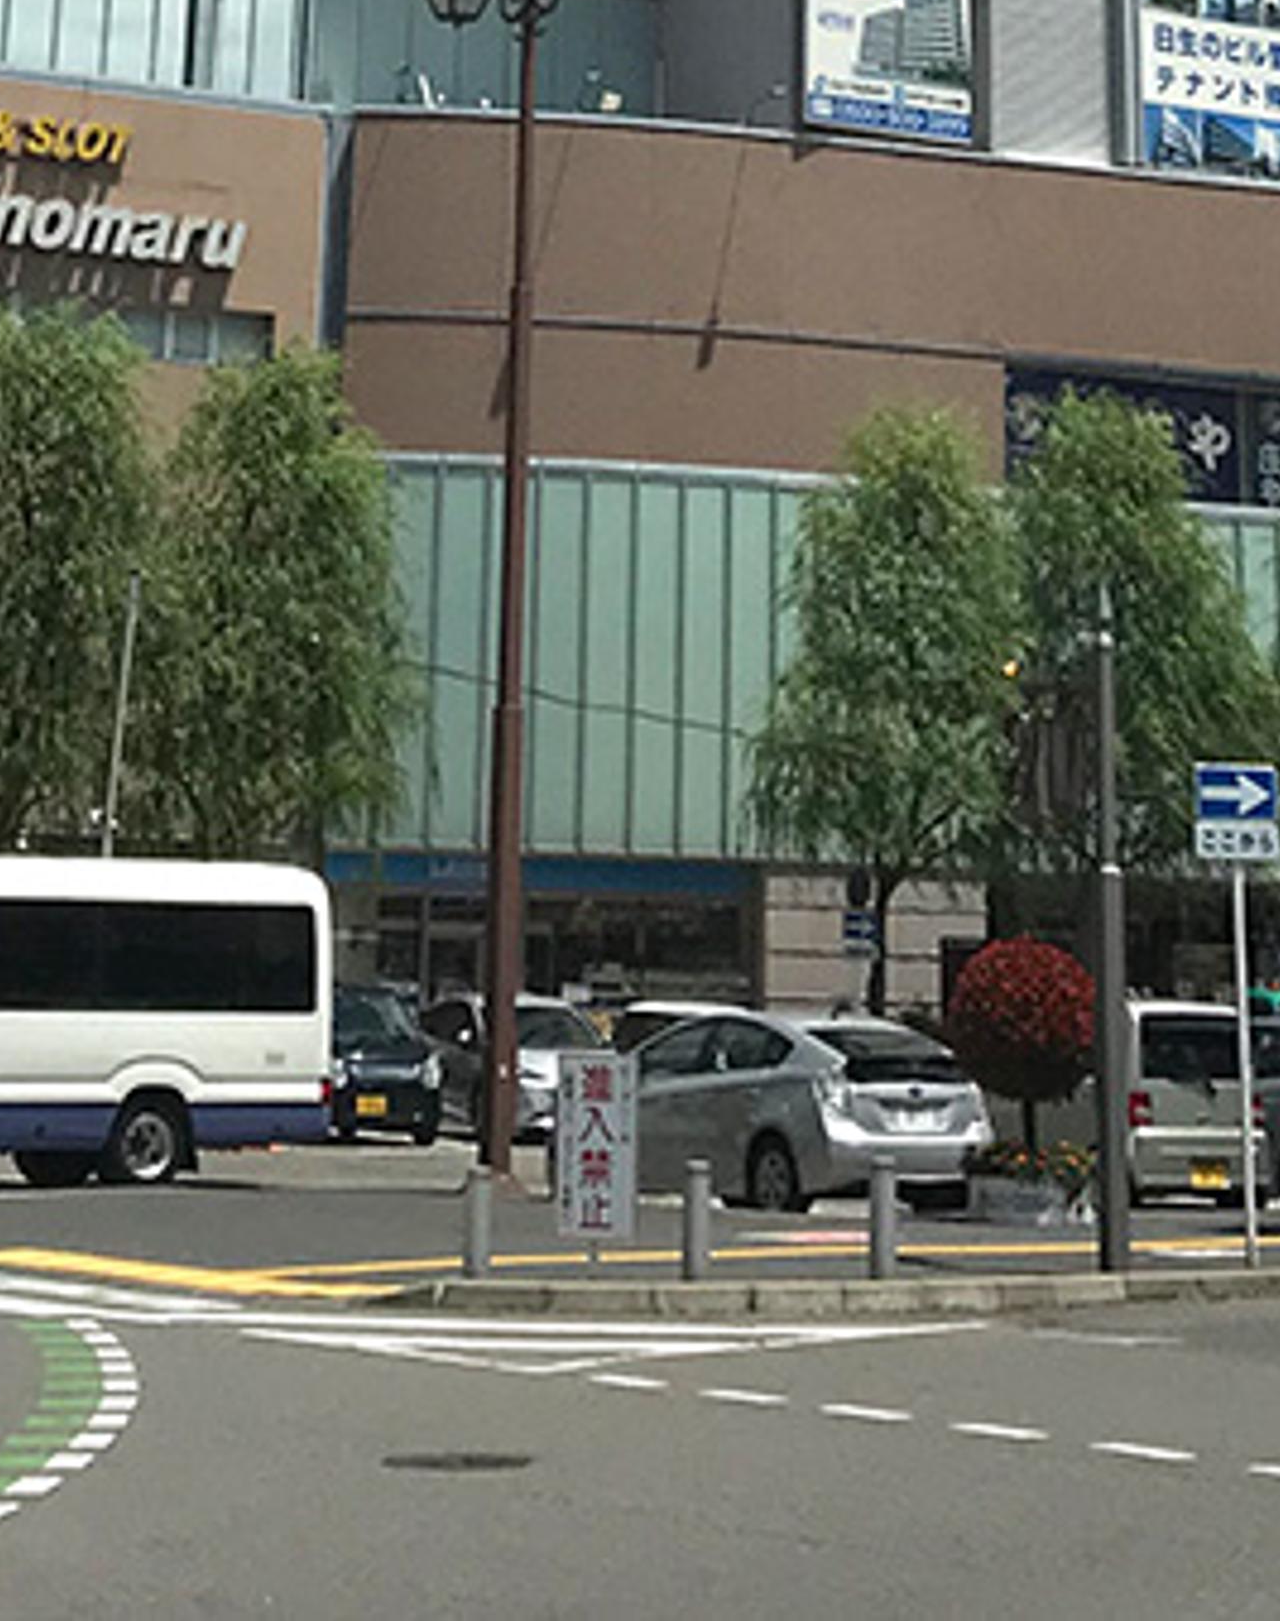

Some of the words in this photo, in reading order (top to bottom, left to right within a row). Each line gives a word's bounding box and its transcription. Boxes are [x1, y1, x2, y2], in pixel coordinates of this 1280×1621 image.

[24, 116, 132, 163] SLOT
[577, 1063, 613, 1232] 進入禁止
